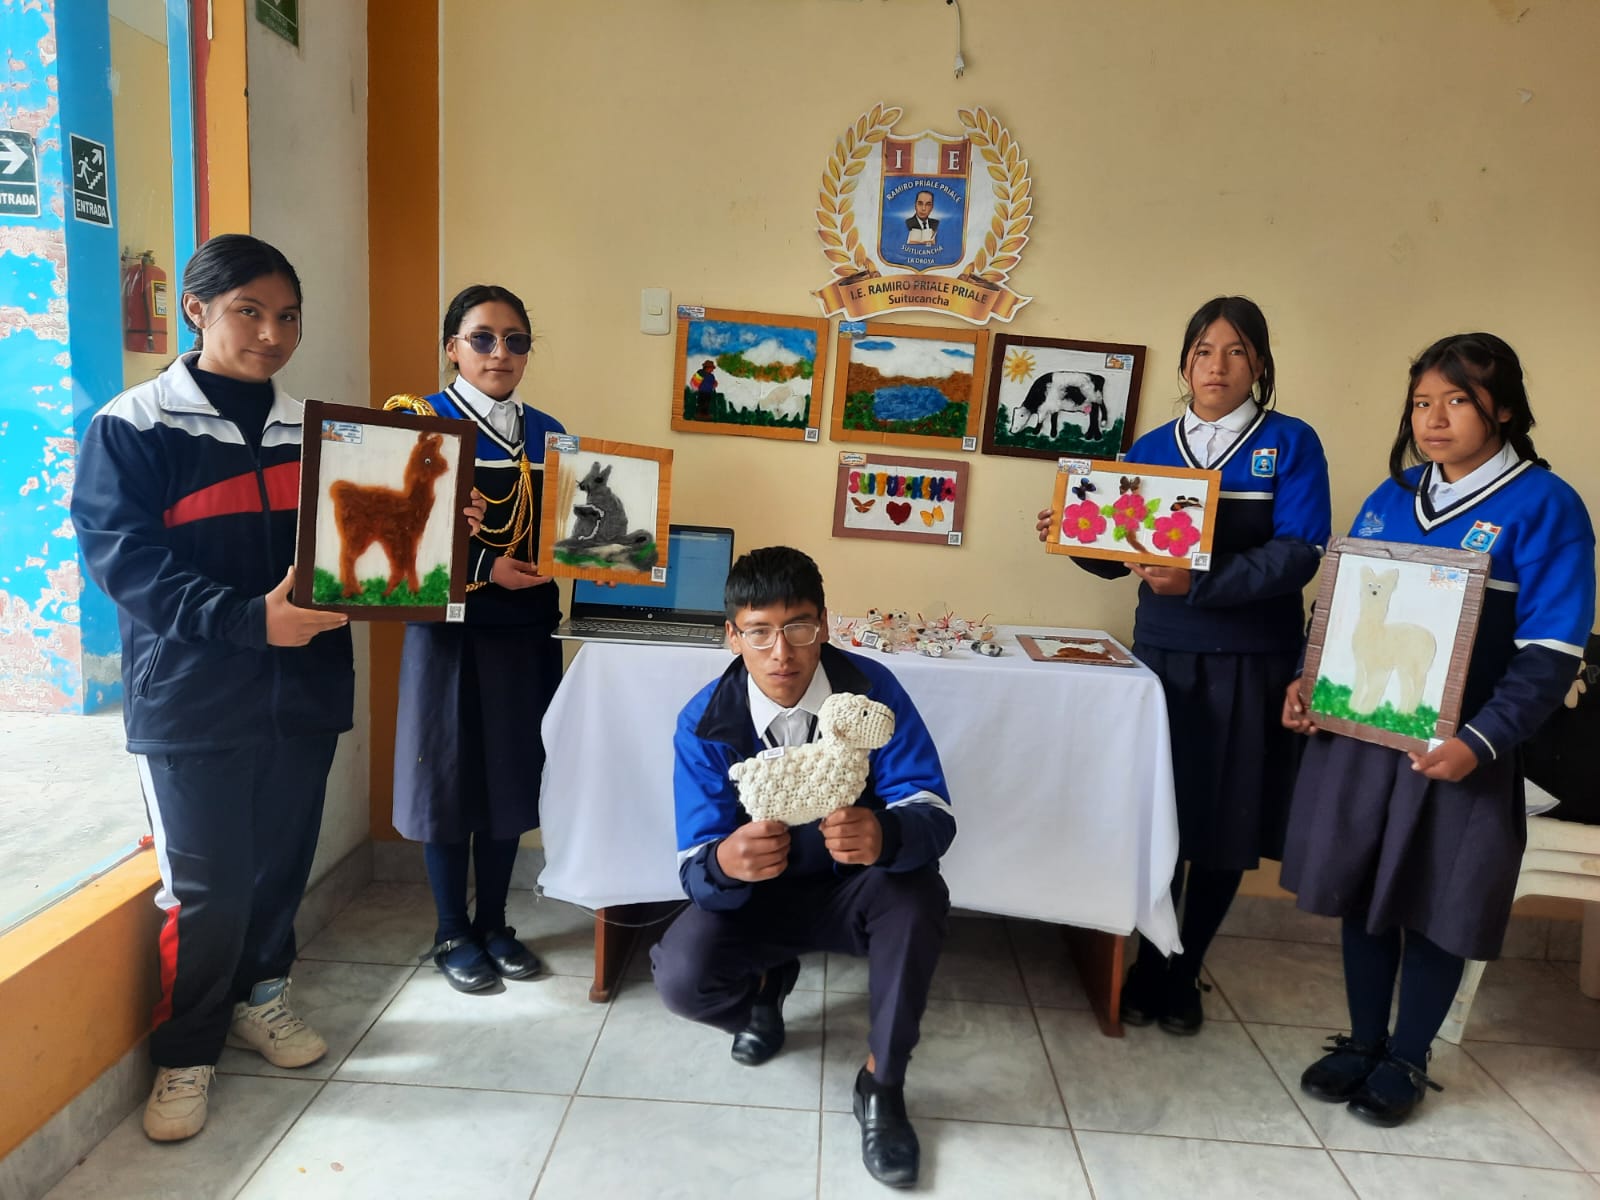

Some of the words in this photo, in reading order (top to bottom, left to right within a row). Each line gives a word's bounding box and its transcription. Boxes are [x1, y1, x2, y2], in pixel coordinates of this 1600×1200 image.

[895, 150, 902, 169] I
[948, 151, 960, 170] E
[0, 192, 36, 206] TRADA
[886, 181, 913, 201] RAMIRO
[915, 180, 939, 188] PRIALE
[939, 184, 961, 203] PRIALE
[76, 199, 107, 218] ENTRADA
[901, 245, 943, 255] SUITUCANCHA
[850, 288, 866, 300] I.E.
[868, 280, 911, 295] RAMIRO
[913, 281, 949, 293] PRIALE
[951, 285, 988, 304] PRIALE
[888, 294, 950, 306] Suitucancha
